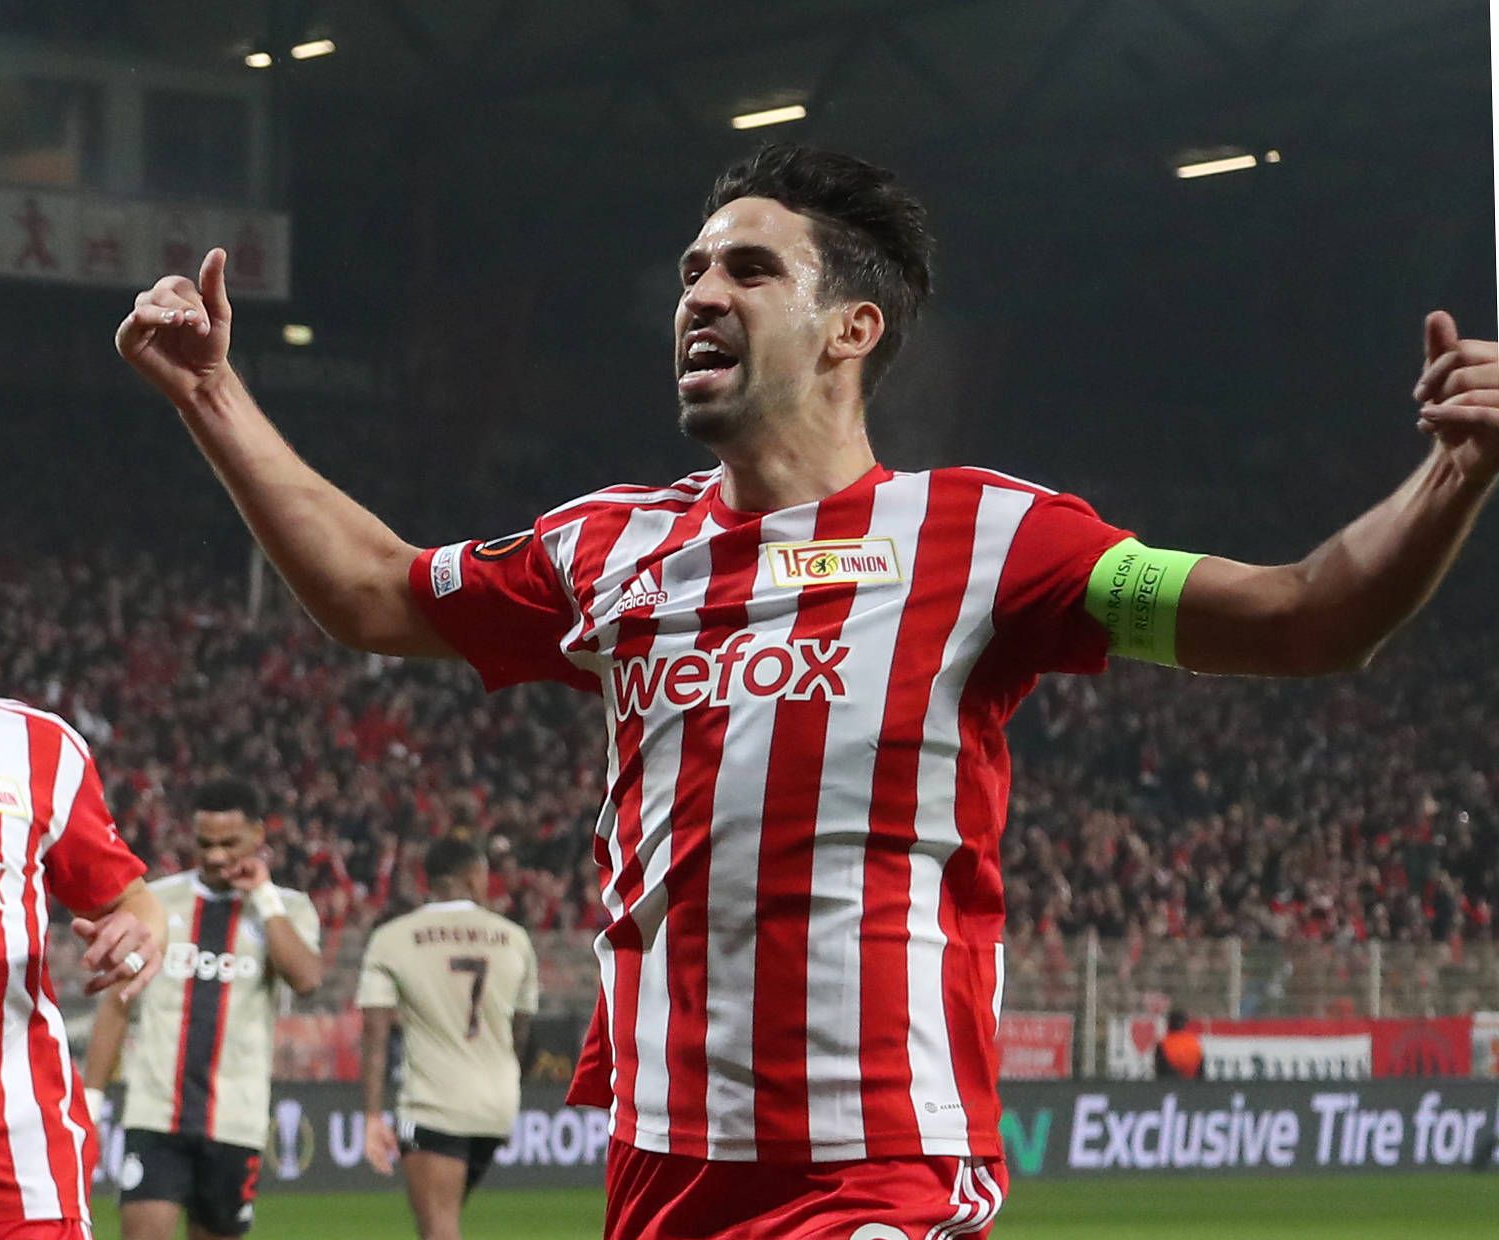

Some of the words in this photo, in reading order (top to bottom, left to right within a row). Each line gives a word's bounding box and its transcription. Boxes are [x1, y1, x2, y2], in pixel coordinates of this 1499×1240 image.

[840, 556, 889, 573] UNION
[1134, 564, 1161, 630] RESPECT
[616, 589, 668, 613] adidas
[612, 632, 851, 720] wefox
[451, 956, 489, 1038] 7
[1067, 1093, 1299, 1168] Exclusive
[1311, 1093, 1402, 1167] Tire
[1413, 1091, 1486, 1165] for
